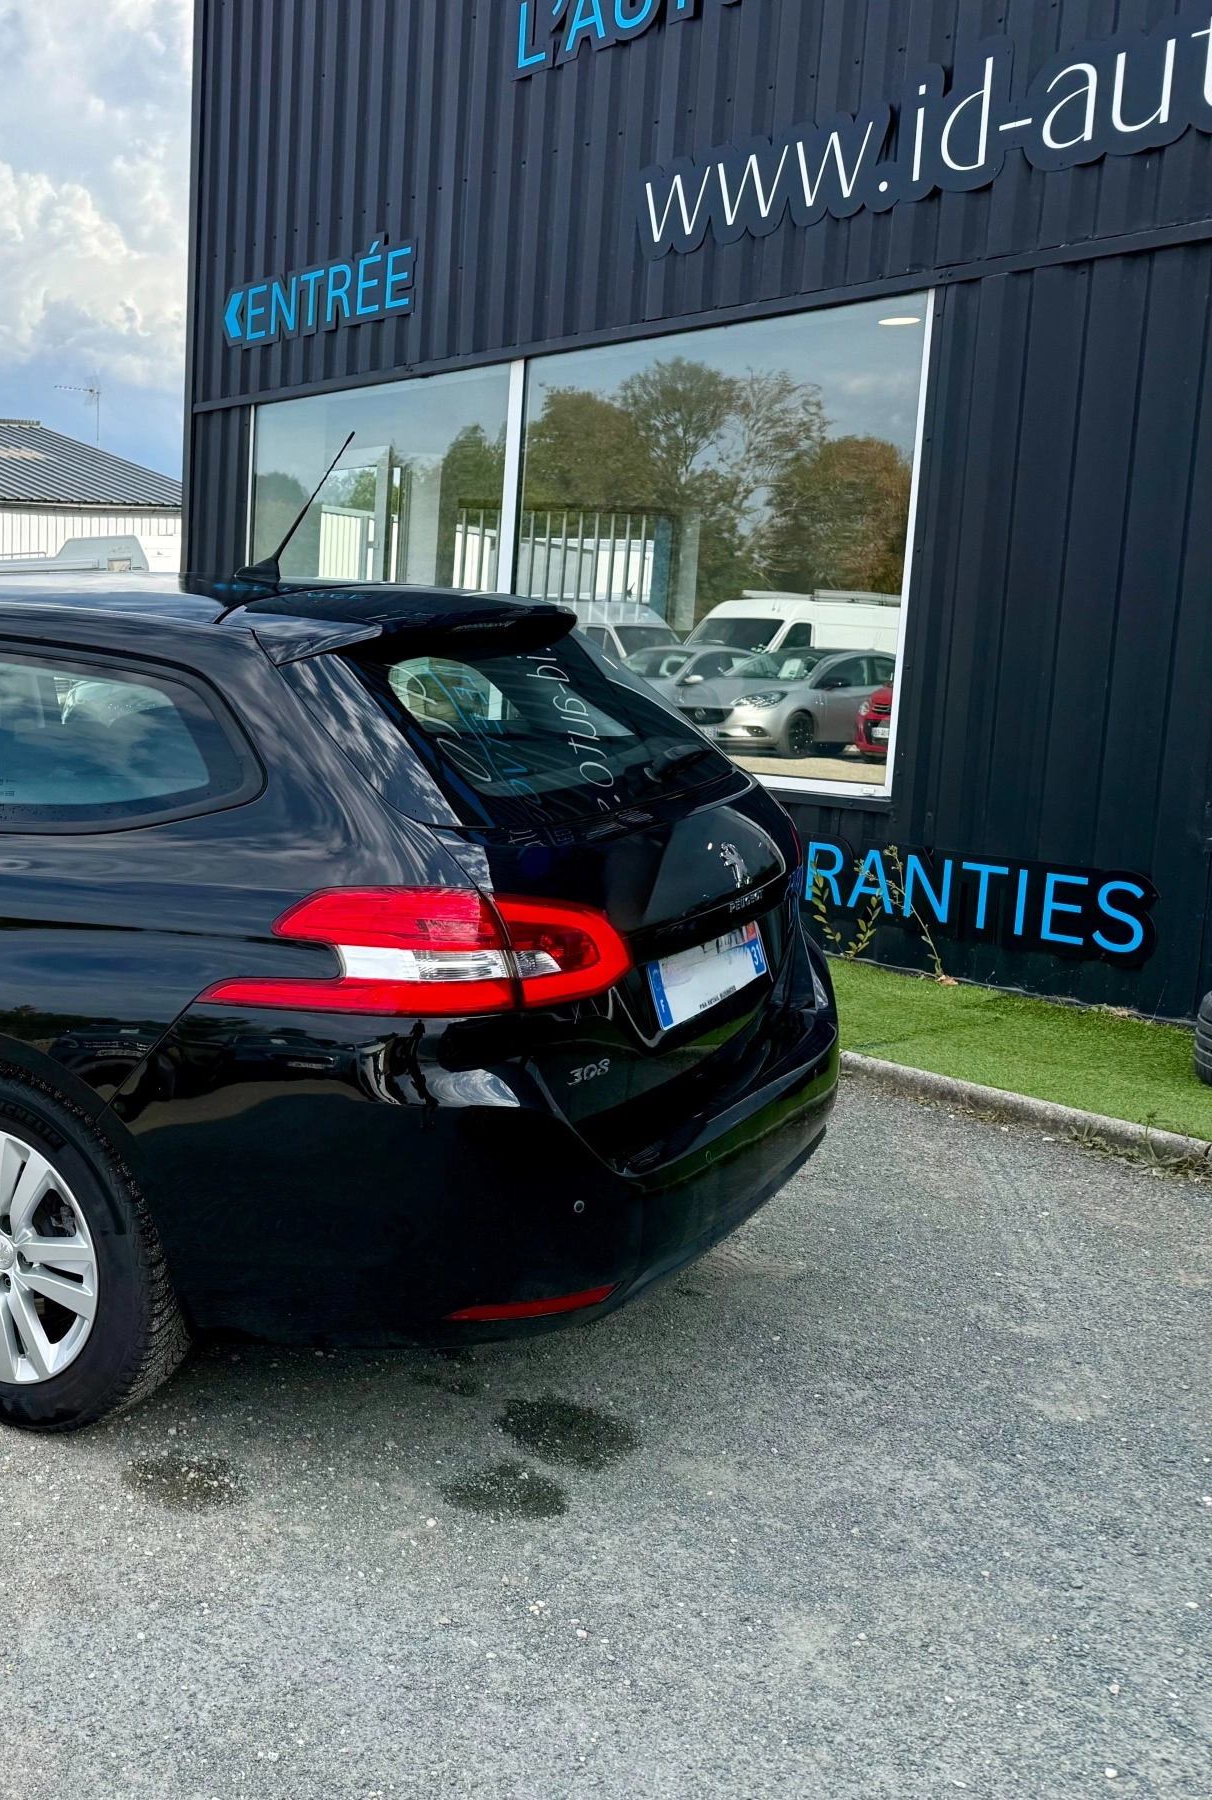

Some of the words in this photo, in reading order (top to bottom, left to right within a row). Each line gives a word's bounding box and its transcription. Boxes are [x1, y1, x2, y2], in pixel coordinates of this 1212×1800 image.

[517, 0, 686, 68] L'A
[246, 240, 413, 341] ENTRÉE
[728, 889, 765, 913] PEUGEOT
[804, 840, 1145, 954] RANTIES
[751, 943, 764, 966] 31
[566, 1058, 611, 1086] 308
